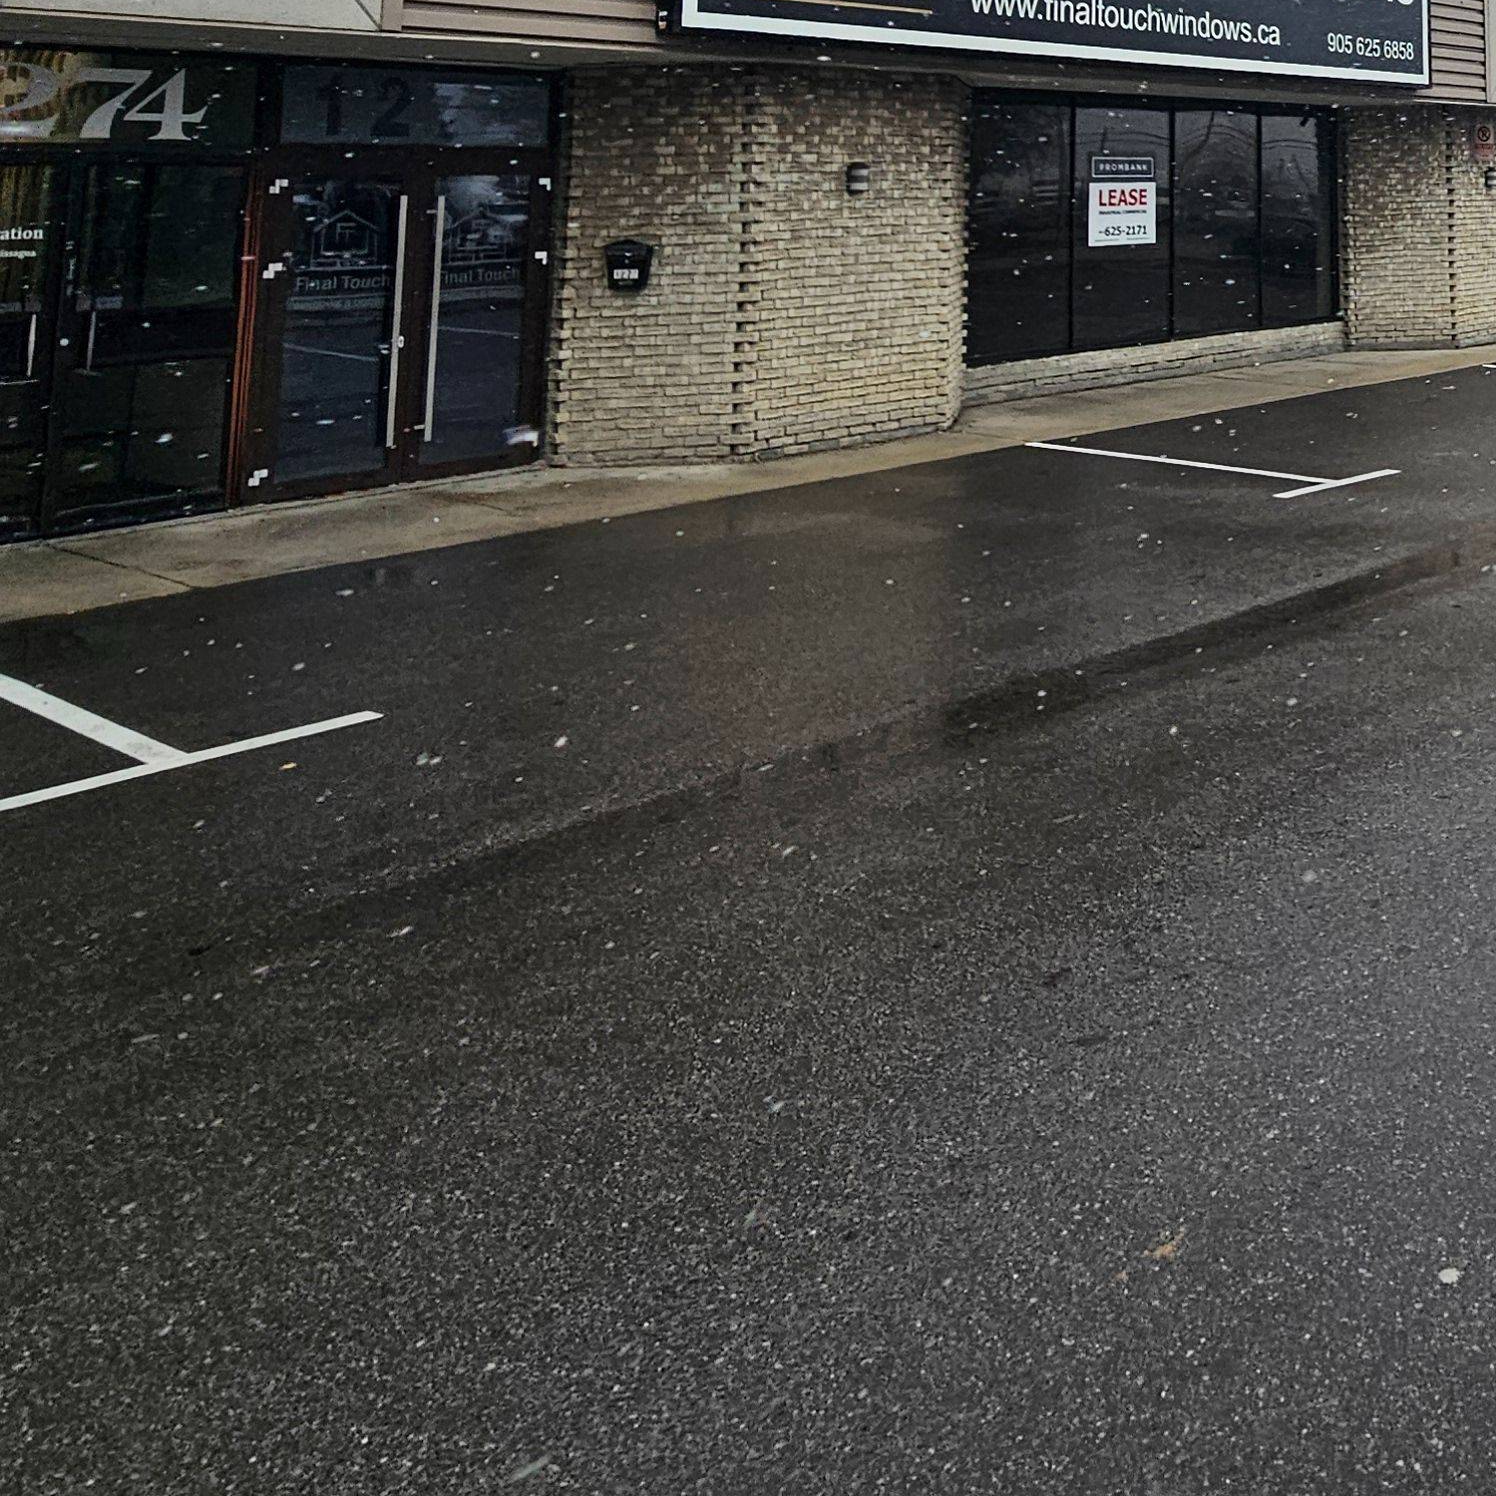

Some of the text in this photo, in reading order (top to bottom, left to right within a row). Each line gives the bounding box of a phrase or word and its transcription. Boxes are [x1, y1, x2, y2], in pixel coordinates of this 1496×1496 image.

[1326, 32, 1414, 61] 905 625 6858
[1099, 163, 1148, 172] PROMBANK
[1098, 188, 1148, 207] LEASE
[295, 274, 390, 292] Final Touch
